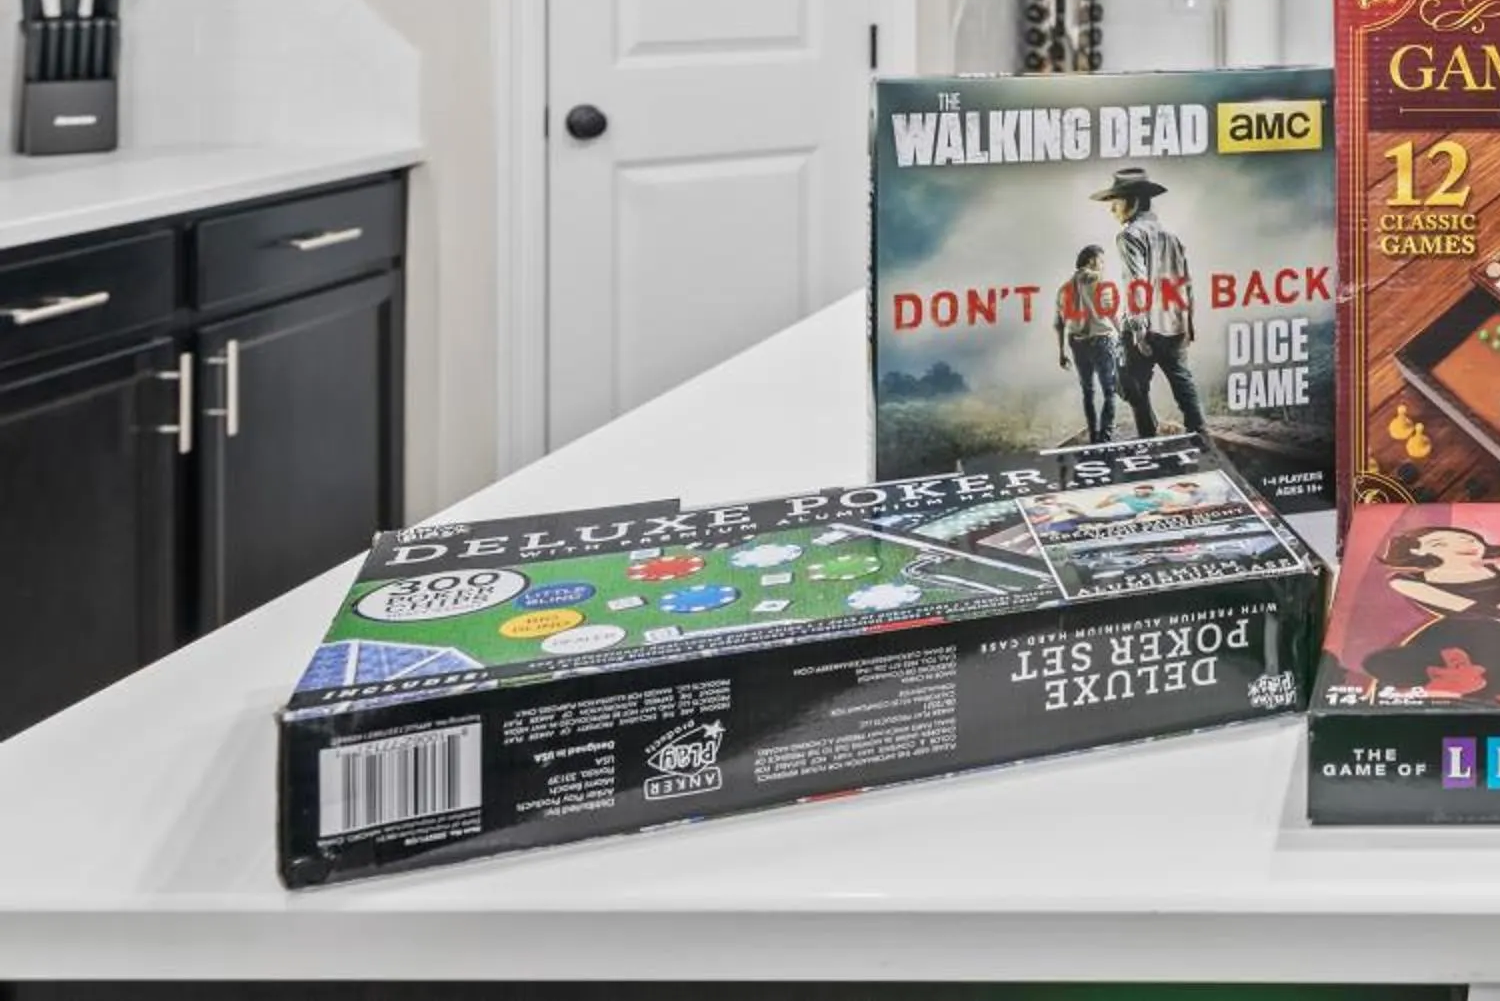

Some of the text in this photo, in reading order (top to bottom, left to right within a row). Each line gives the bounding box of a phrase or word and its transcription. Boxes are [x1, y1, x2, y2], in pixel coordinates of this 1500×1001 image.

[938, 92, 961, 110] THE
[892, 104, 1208, 168] WALKING DEAD
[1383, 140, 1472, 207] 12
[1380, 214, 1476, 234] CLASSIC
[1381, 234, 1476, 256] GAMES
[893, 266, 1330, 331] DON'T LOOK BACK
[1228, 318, 1309, 367] DICE
[1227, 366, 1309, 411] GAME
[787, 448, 1200, 517] POKER SET
[1275, 484, 1304, 497] AGES
[1278, 471, 1322, 485] PLAYERS
[385, 505, 750, 565] DELUXE
[520, 544, 600, 558] WITH
[620, 522, 757, 546] PREMIUM
[777, 498, 943, 526] ALUMINIUM
[961, 483, 1035, 500] HARD
[389, 585, 496, 605] POKER
[390, 572, 499, 595] 300
[981, 602, 1277, 654] WITH PREMIUM ALUMINIUM HARD CASE
[1109, 619, 1249, 666] POKER
[1011, 641, 1092, 682] SET
[1045, 656, 1218, 711] DELUXE
[567, 740, 615, 755] Designed
[644, 719, 695, 754] products
[533, 751, 555, 763] USA
[595, 755, 614, 765] USA
[1323, 763, 1427, 776] GAME OF
[1352, 749, 1396, 761] THE
[650, 773, 716, 795] ANKER
